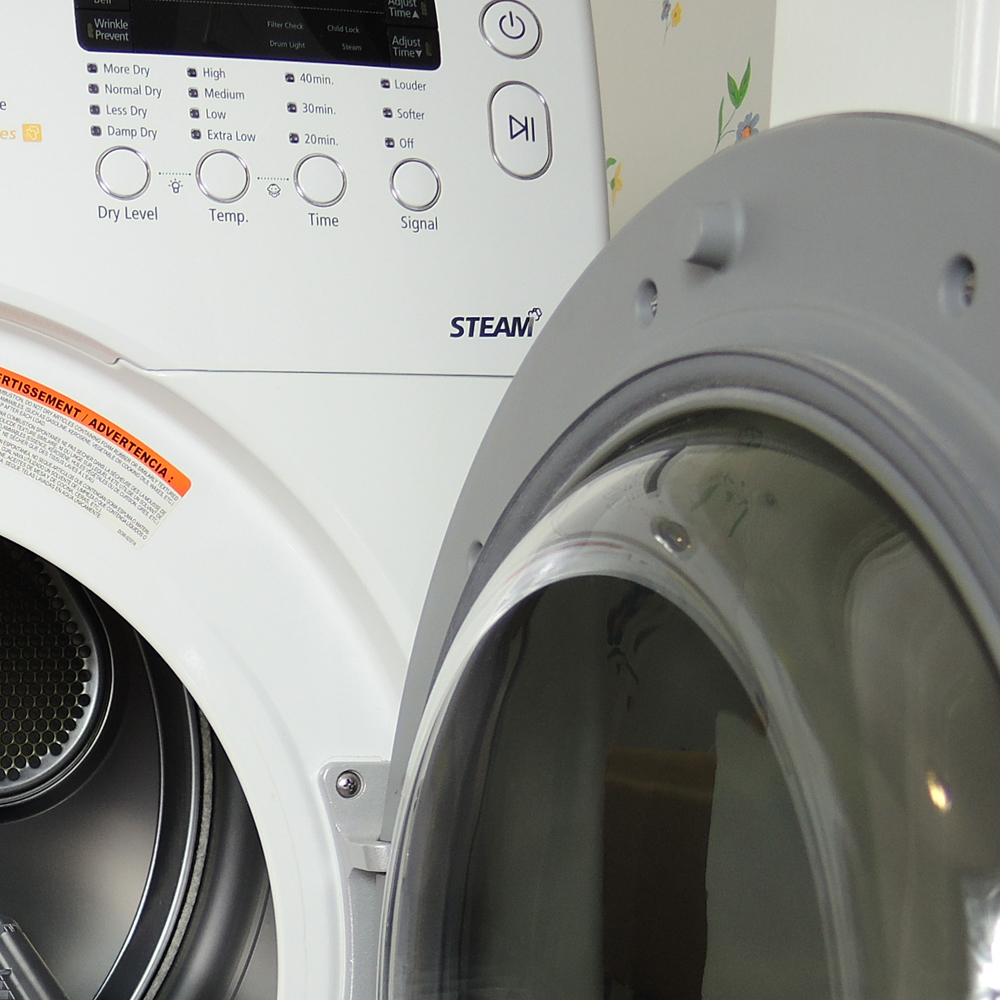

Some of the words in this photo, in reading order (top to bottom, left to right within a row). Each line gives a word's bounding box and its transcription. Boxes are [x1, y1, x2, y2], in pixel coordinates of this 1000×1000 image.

[389, 7, 411, 17] Time
[93, 18, 129, 30] Wrinkle
[267, 20, 283, 29] Filter
[284, 22, 304, 30] Check
[327, 24, 344, 33] Child
[345, 26, 360, 34] Lock
[95, 30, 130, 42] Prevent
[269, 40, 288, 48] Drum
[289, 41, 306, 50] Light
[341, 43, 362, 52] Steam
[391, 36, 421, 50] Adjust
[393, 48, 416, 58] Time
[103, 64, 130, 75] More
[133, 64, 150, 78] Dry
[203, 67, 226, 81] High
[300, 73, 334, 86] 40min.
[394, 79, 427, 92] Louder
[105, 84, 142, 96] Normal
[145, 85, 162, 99] Dry
[204, 88, 245, 101] Medium
[106, 104, 128, 116] Less
[130, 105, 148, 119] Dry
[205, 108, 227, 120] Low
[302, 102, 336, 115] 30min.
[397, 108, 425, 121] Softer
[107, 126, 138, 139] Damp
[140, 127, 158, 141] Dry
[207, 129, 233, 141] Extra
[235, 130, 257, 142] Low
[304, 133, 339, 147] 20min.
[399, 137, 415, 149] Off
[97, 205, 120, 223] Dry
[124, 206, 159, 221] Level
[209, 208, 249, 226] Temp.
[308, 213, 340, 228] Time
[400, 216, 439, 233] Signal
[449, 316, 535, 338] STEAM
[87, 417, 170, 477] ADVERTENCIA
